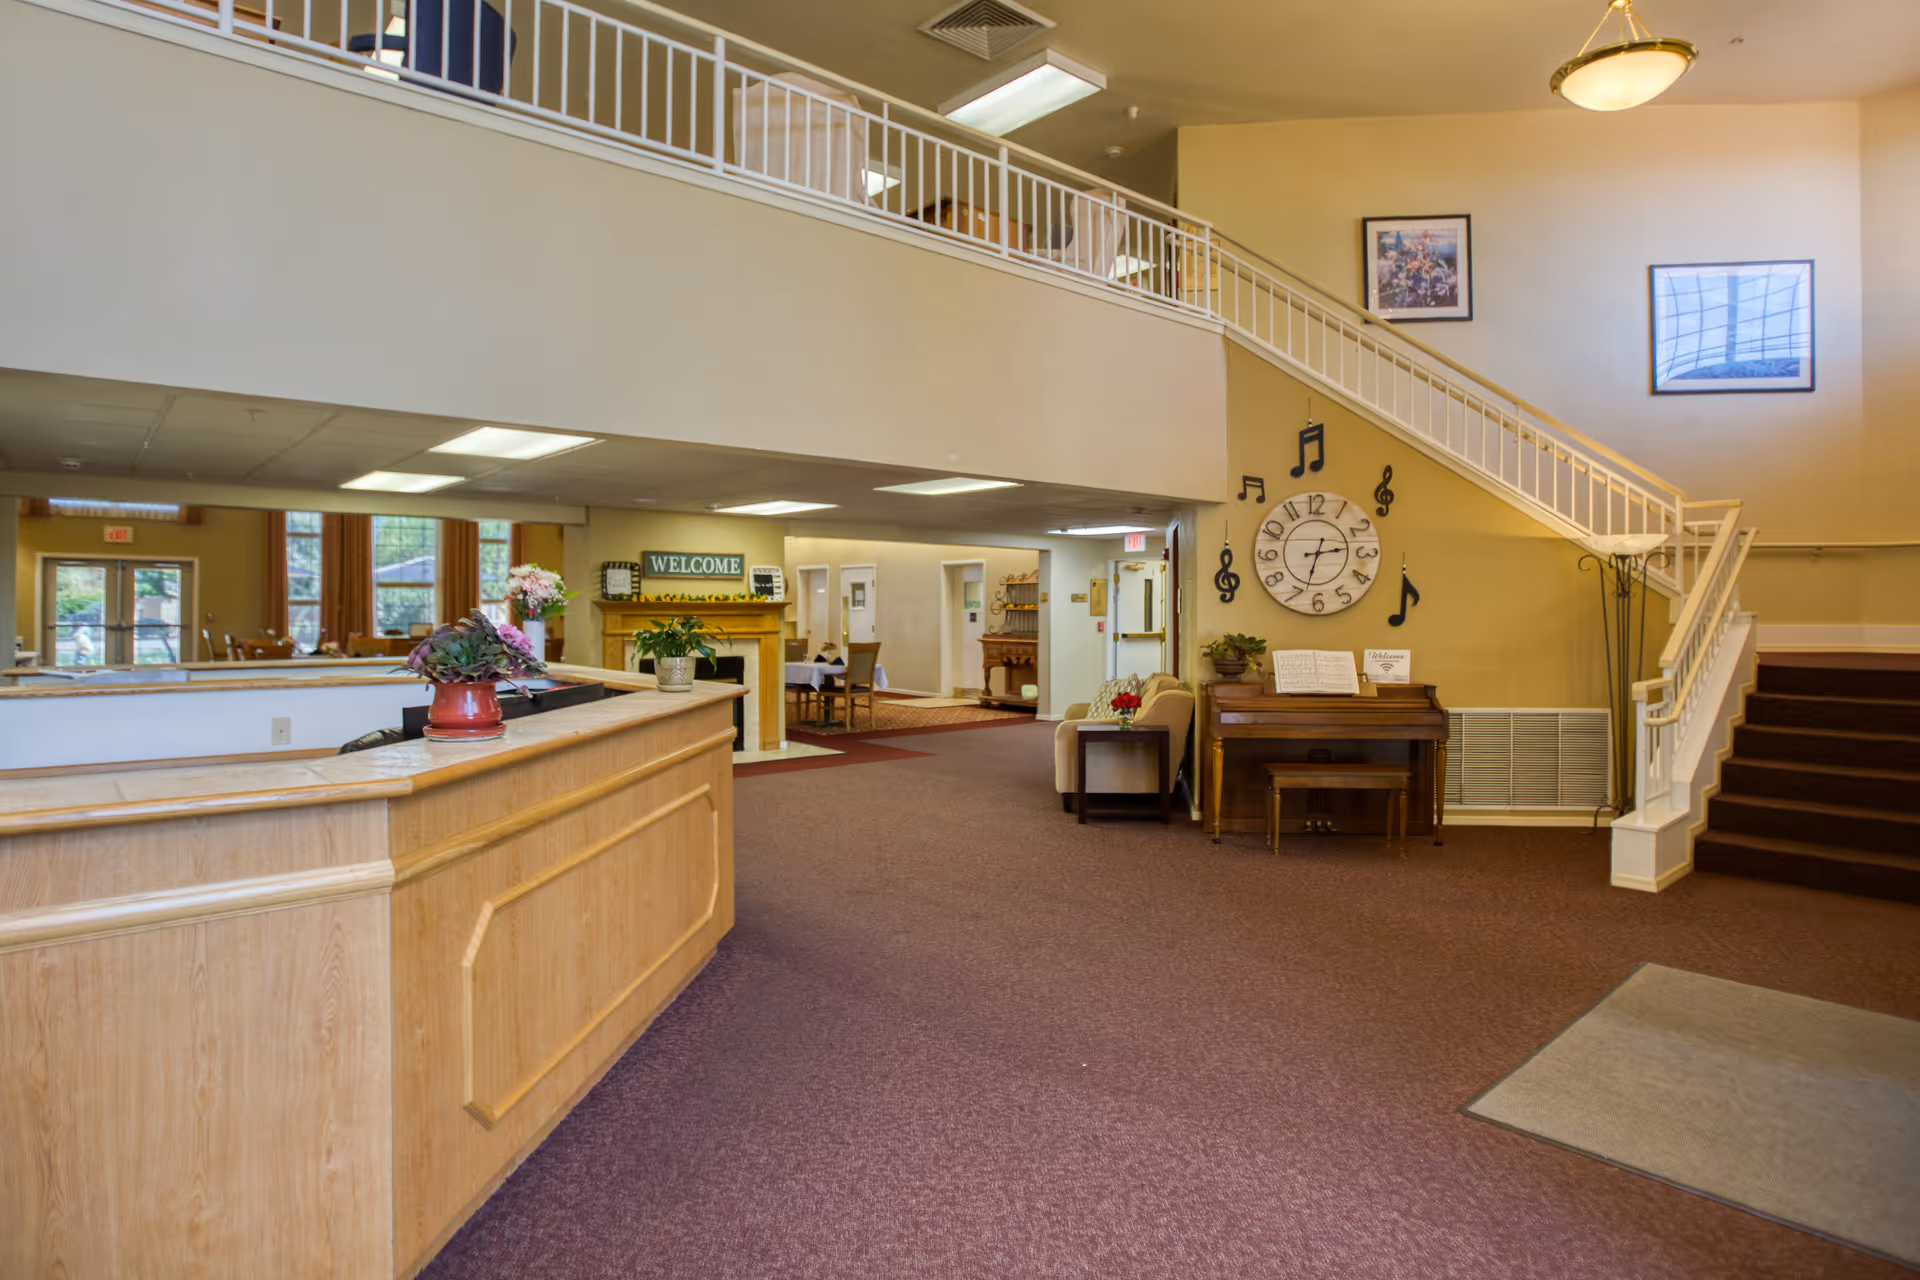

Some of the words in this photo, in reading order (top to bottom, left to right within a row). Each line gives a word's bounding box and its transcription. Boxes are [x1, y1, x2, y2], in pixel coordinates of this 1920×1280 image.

[1283, 501, 1300, 521] 11
[1308, 494, 1325, 515] 12
[1335, 500, 1347, 519] 1
[1263, 519, 1284, 540] 10
[1350, 519, 1370, 537] 2
[1128, 535, 1141, 549] EXIT
[1258, 549, 1278, 561] 9
[1356, 546, 1378, 559] 3
[650, 555, 741, 574] WELCOME
[1265, 571, 1284, 587] 8
[1352, 569, 1372, 585] 4
[1284, 585, 1304, 602] 7
[1312, 593, 1324, 612] 6
[1335, 585, 1352, 604] 5
[1368, 651, 1405, 660] Welcome
